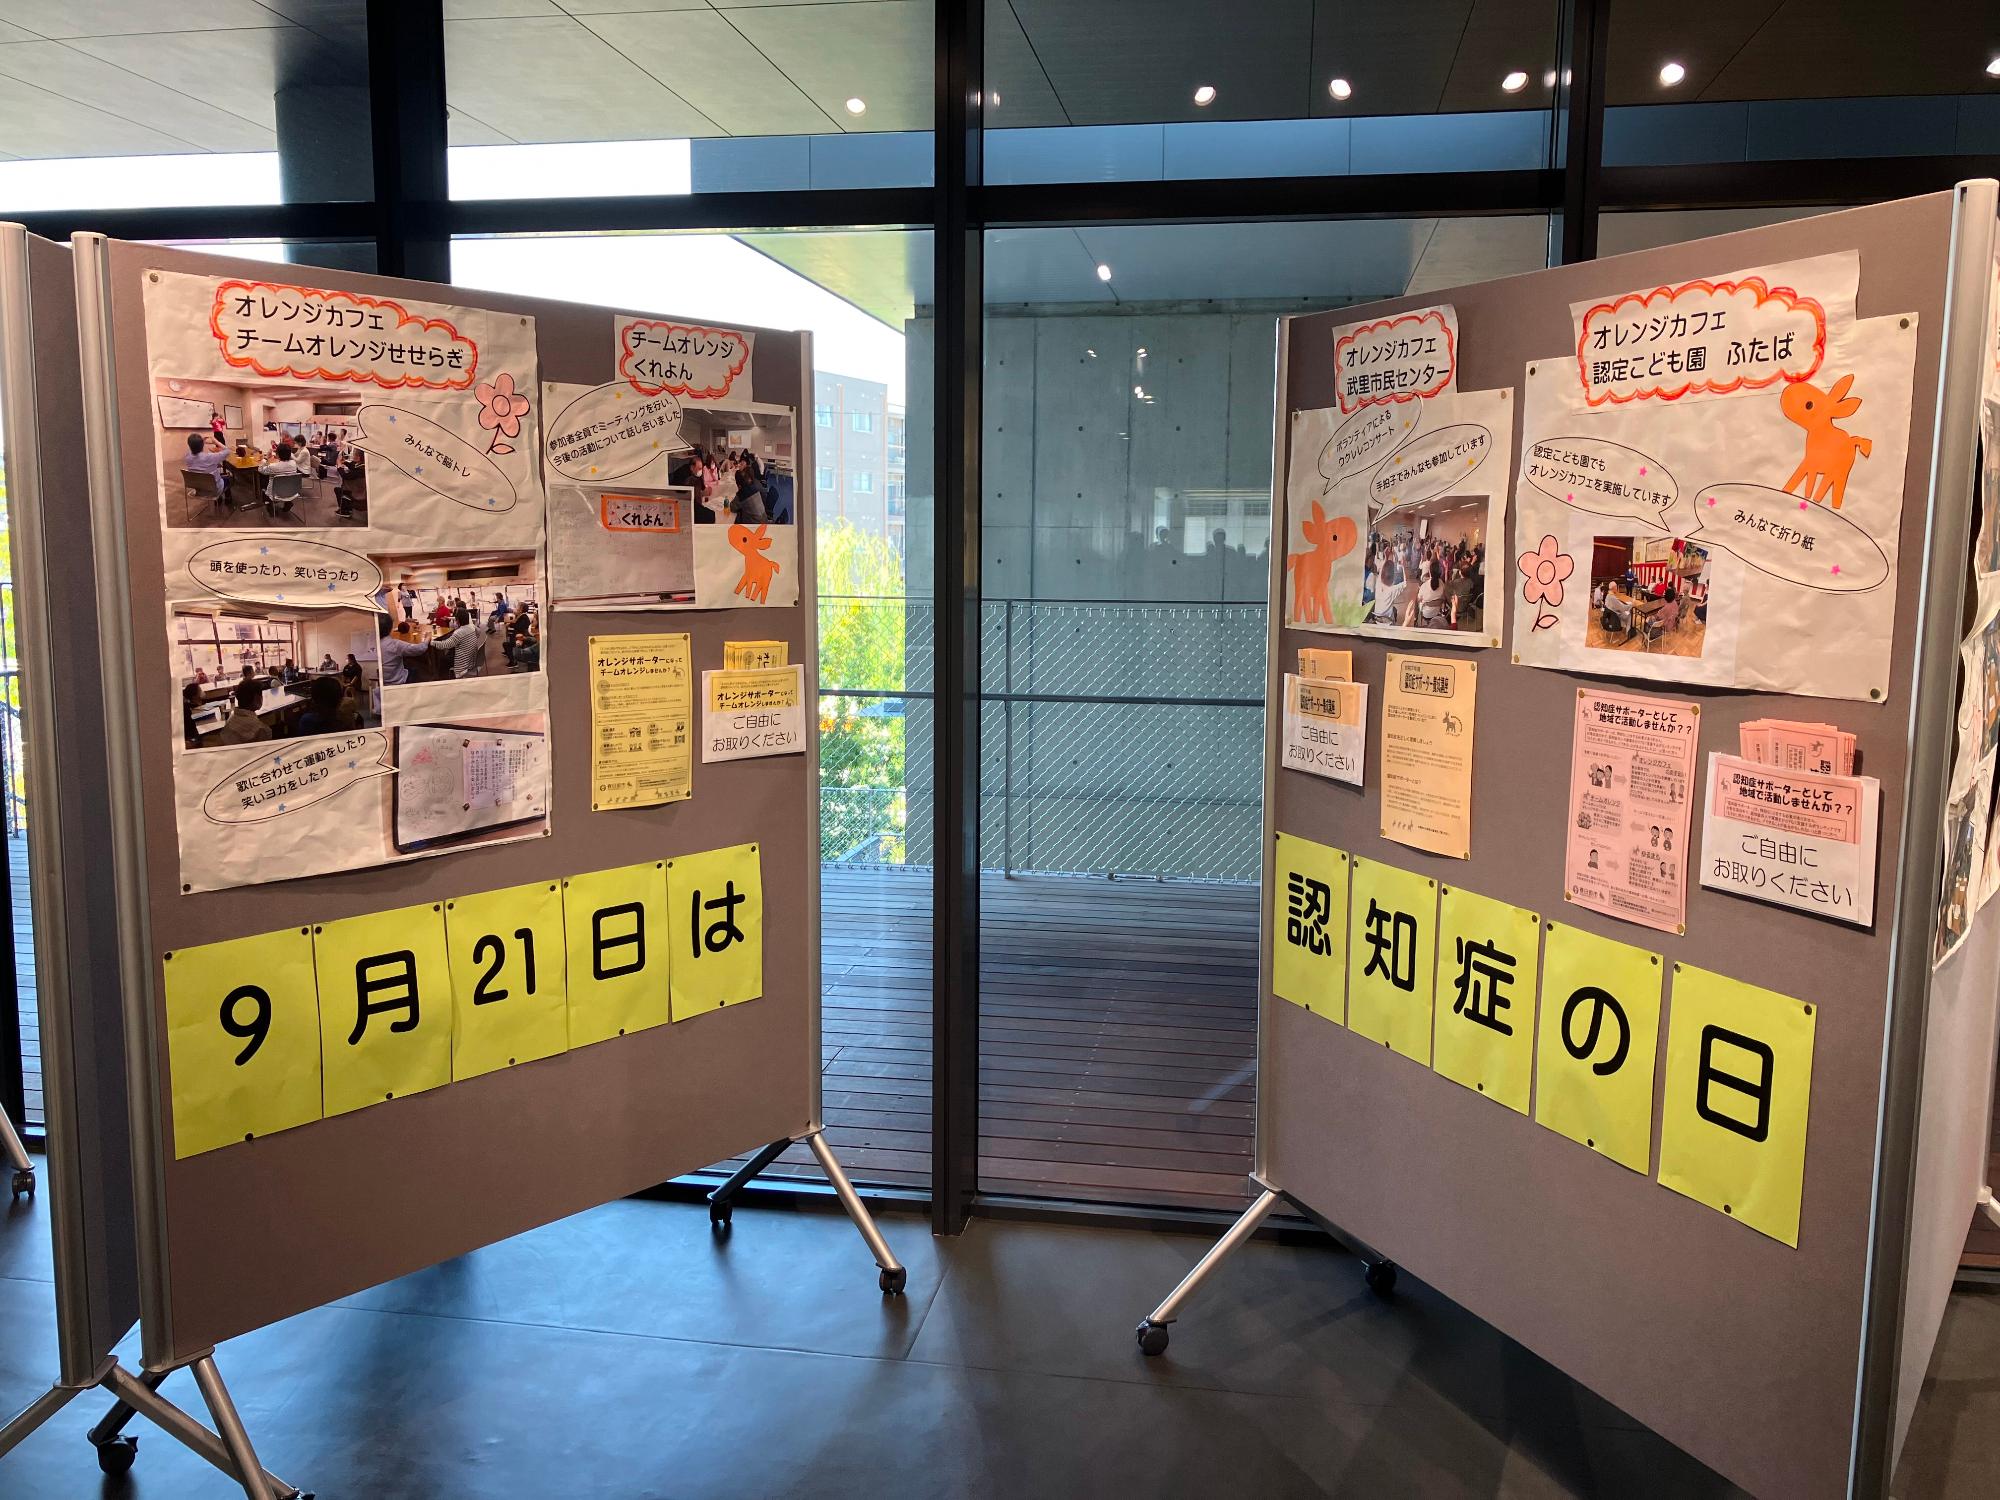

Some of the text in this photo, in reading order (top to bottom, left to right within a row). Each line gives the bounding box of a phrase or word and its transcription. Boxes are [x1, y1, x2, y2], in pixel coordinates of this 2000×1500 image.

[235, 296, 384, 330] オレンジカフェ
[1594, 310, 1726, 349] オレンジカフェ
[237, 329, 464, 369] チームオレンジせせらぎ
[632, 331, 736, 358] チームオレンジ
[1347, 337, 1436, 367] オレンジカフェ
[1593, 332, 1795, 385] 認定こども園 ふたば
[634, 360, 693, 380] くれよん
[1347, 364, 1450, 395] 武里市民センター
[550, 397, 674, 451] 参加者全員でミーティングを行い、
[553, 410, 681, 467] 今後の活動について話し合いました
[1336, 410, 1392, 453] ボランティアによる
[404, 432, 472, 478] みんなで脳トレ
[1376, 434, 1485, 493] 手拍子でみんなも参加しています
[1534, 445, 1606, 472] 認定こども園でも
[1529, 464, 1671, 507] オレンジカフェを実施しています
[622, 512, 664, 527] くれよん
[1734, 509, 1815, 552] みんなで折り紙
[210, 559, 360, 582] 頭を使ったり、笑い合ったり
[733, 713, 781, 729] ご自由に
[1593, 701, 1678, 723] 認知症サポーターとして
[713, 731, 797, 752] お取りください
[1301, 725, 1339, 746] ご自由に
[236, 735, 367, 793] 歌に合わせて運動をしたり
[1289, 744, 1355, 772] お取りください
[241, 768, 329, 810] 笑いヨガをしたり
[1732, 773, 1834, 800] 認知症サポーターとして
[1743, 834, 1818, 868] ご自由に
[1713, 858, 1852, 906] お取りください
[219, 881, 745, 1066] 9月21日は
[1287, 872, 1774, 1143] 認知症の日
